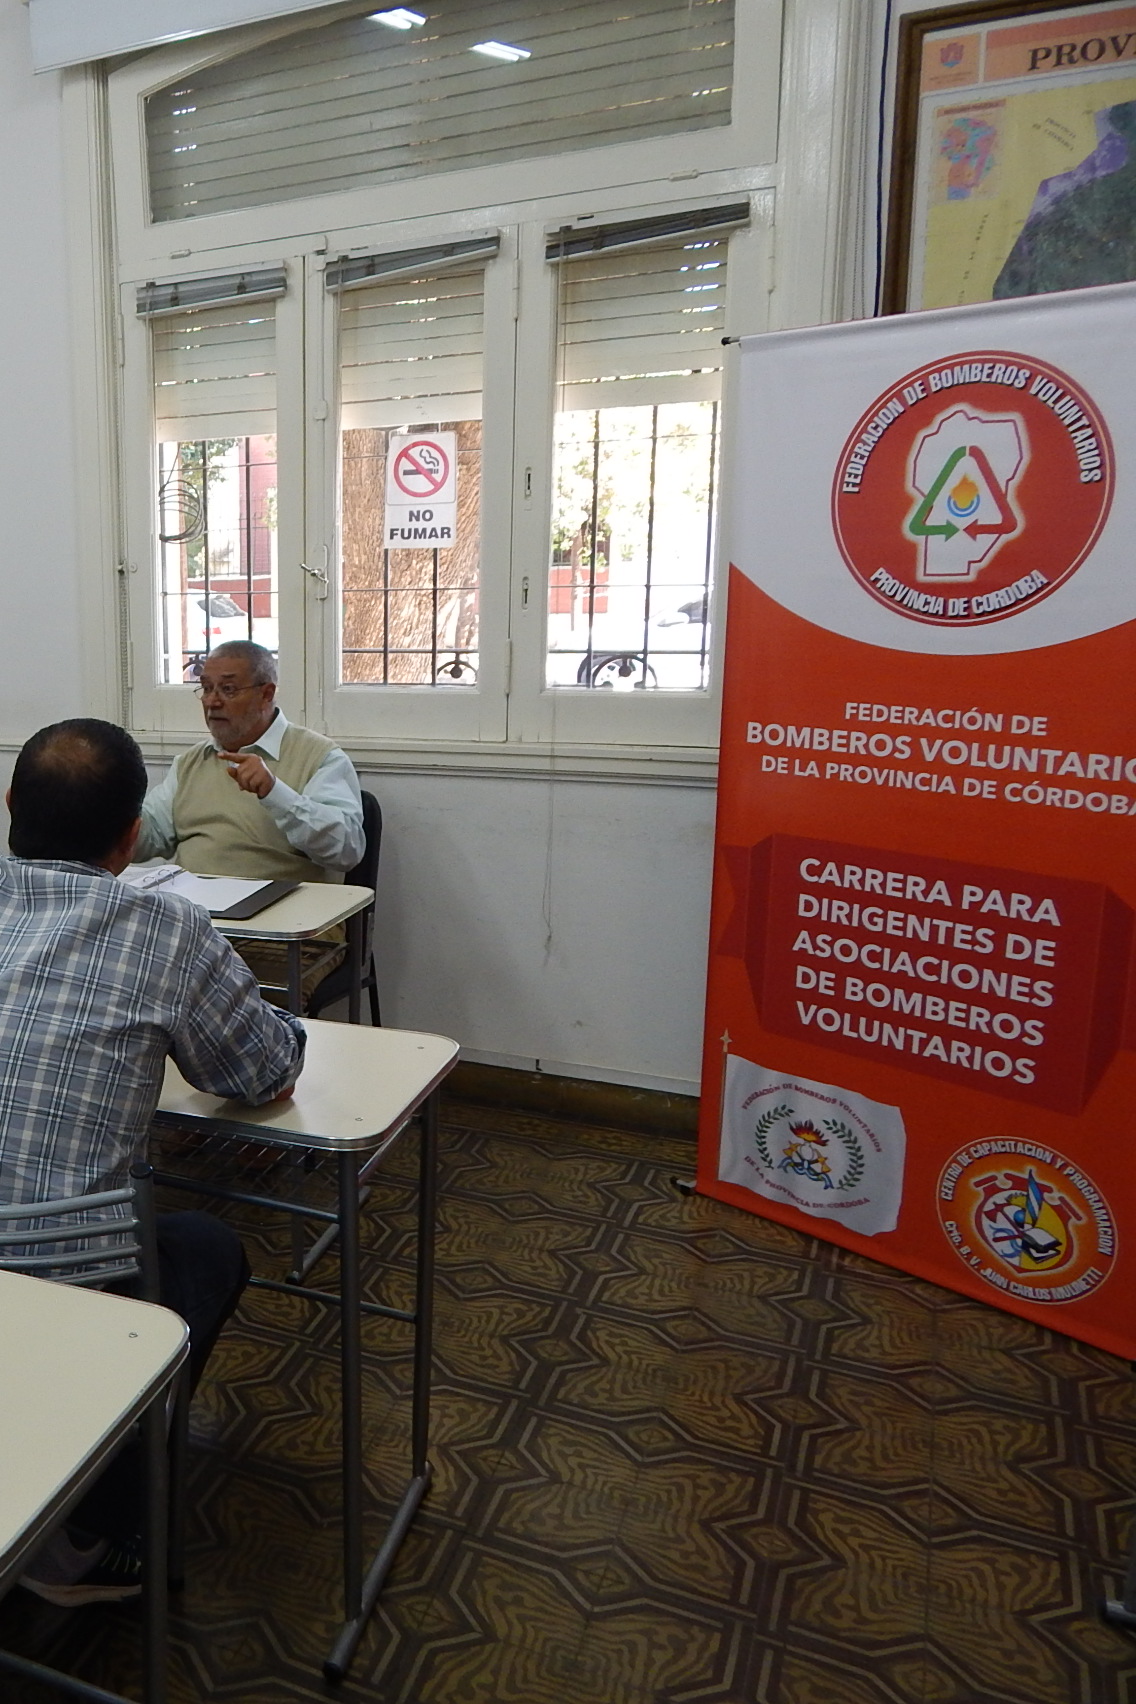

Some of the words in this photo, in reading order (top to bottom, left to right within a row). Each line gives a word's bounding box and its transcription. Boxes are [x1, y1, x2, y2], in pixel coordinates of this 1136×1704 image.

[1028, 32, 1136, 71] PROV
[843, 398, 906, 494] FEDERACION
[903, 380, 928, 405] DE
[928, 362, 1031, 394] BOMBEROS
[1028, 375, 1103, 484] VOLUNTARIOS
[389, 526, 452, 540] FUMAR
[408, 509, 434, 522] NO
[869, 567, 944, 615] PROVINCIA
[947, 598, 968, 616] DE
[971, 569, 1049, 613] CORDOBA
[746, 721, 912, 760] BOMBEROS
[845, 701, 1003, 732] FEDERACIÓN
[1010, 714, 1048, 736] DE
[761, 755, 789, 775] DE
[794, 758, 820, 778] LA
[825, 762, 957, 795] PROVINCIA
[962, 777, 997, 799] DE
[799, 857, 953, 907] CARRERA
[961, 884, 1061, 927] PARA
[797, 893, 995, 954] DIRIGENTES
[1005, 933, 1057, 967] DE
[792, 930, 1055, 1008] ASOCIACIONES
[795, 965, 836, 996] DE
[844, 976, 1045, 1046] BOMBEROS
[796, 1001, 1036, 1085] VOLUNTARIOS
[794, 1084, 838, 1104] BOMBEROS
[839, 1100, 883, 1153] VOLUNTARIOS
[744, 1155, 757, 1167] DE
[755, 1167, 765, 1179] LA
[941, 1165, 963, 1201] CENTRO
[957, 1152, 973, 1167] DE
[970, 1140, 1054, 1164] CAPACITACION
[1054, 1156, 1064, 1169] Y
[1063, 1167, 1113, 1256] PROGRAMACION
